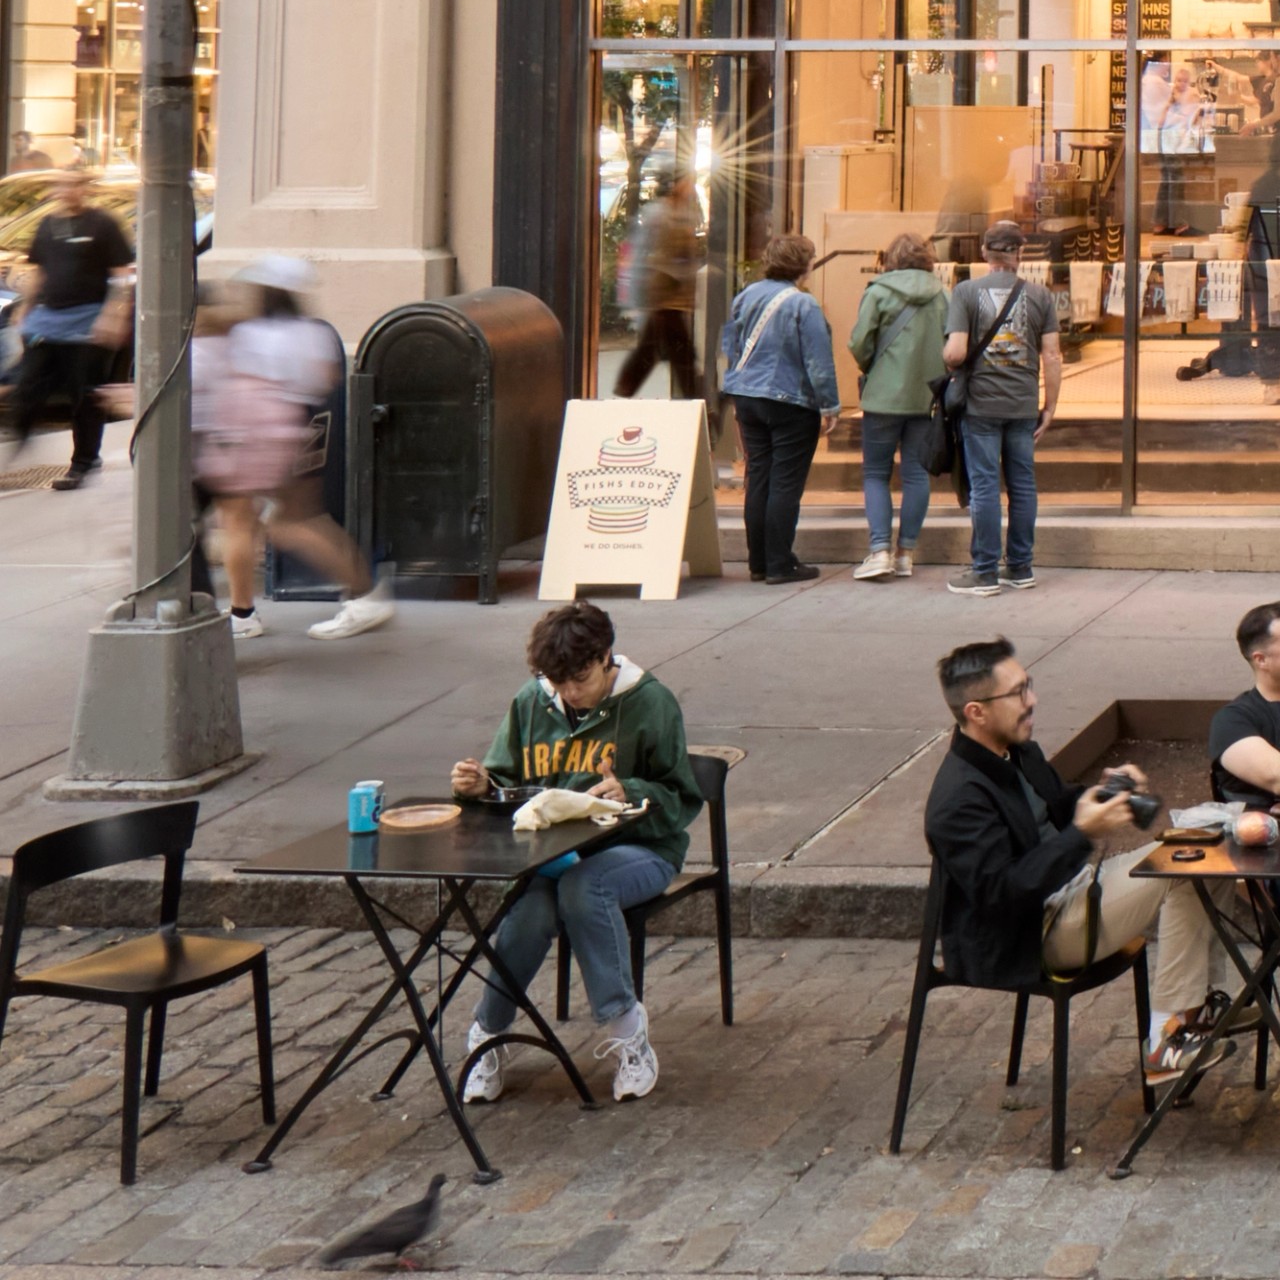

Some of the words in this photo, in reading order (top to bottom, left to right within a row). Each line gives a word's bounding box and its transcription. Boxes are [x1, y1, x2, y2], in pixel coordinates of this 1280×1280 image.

[1113, 19, 1170, 32] SUNER
[585, 480, 622, 490] FISHS
[631, 480, 662, 490] EDDY
